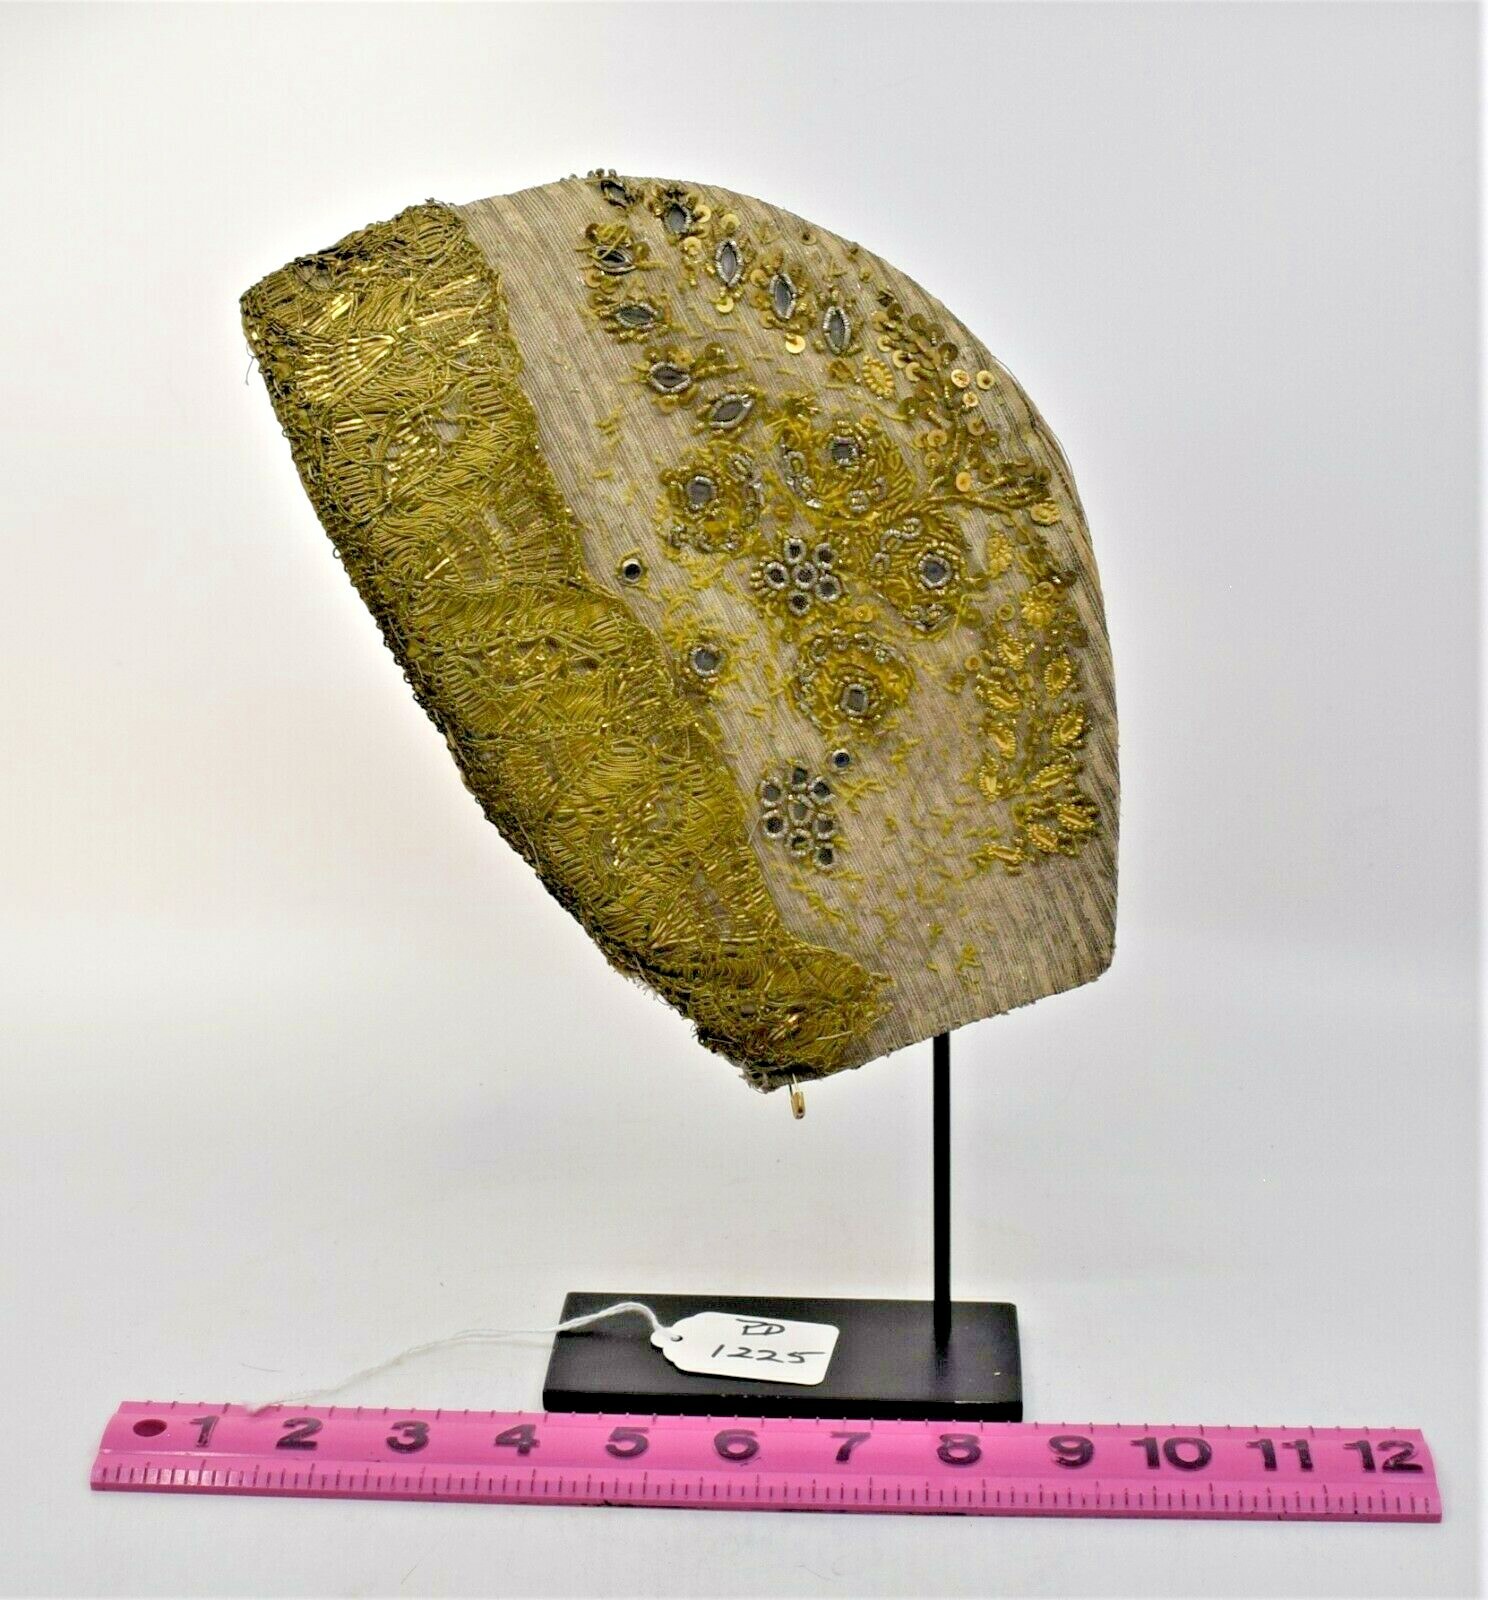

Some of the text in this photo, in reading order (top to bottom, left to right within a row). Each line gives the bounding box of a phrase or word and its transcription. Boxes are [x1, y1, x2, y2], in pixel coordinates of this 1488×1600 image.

[711, 1344, 826, 1364] 1225
[190, 1416, 1423, 1473] 1 2 3 4 5 6 7 8 9 10 11 12
